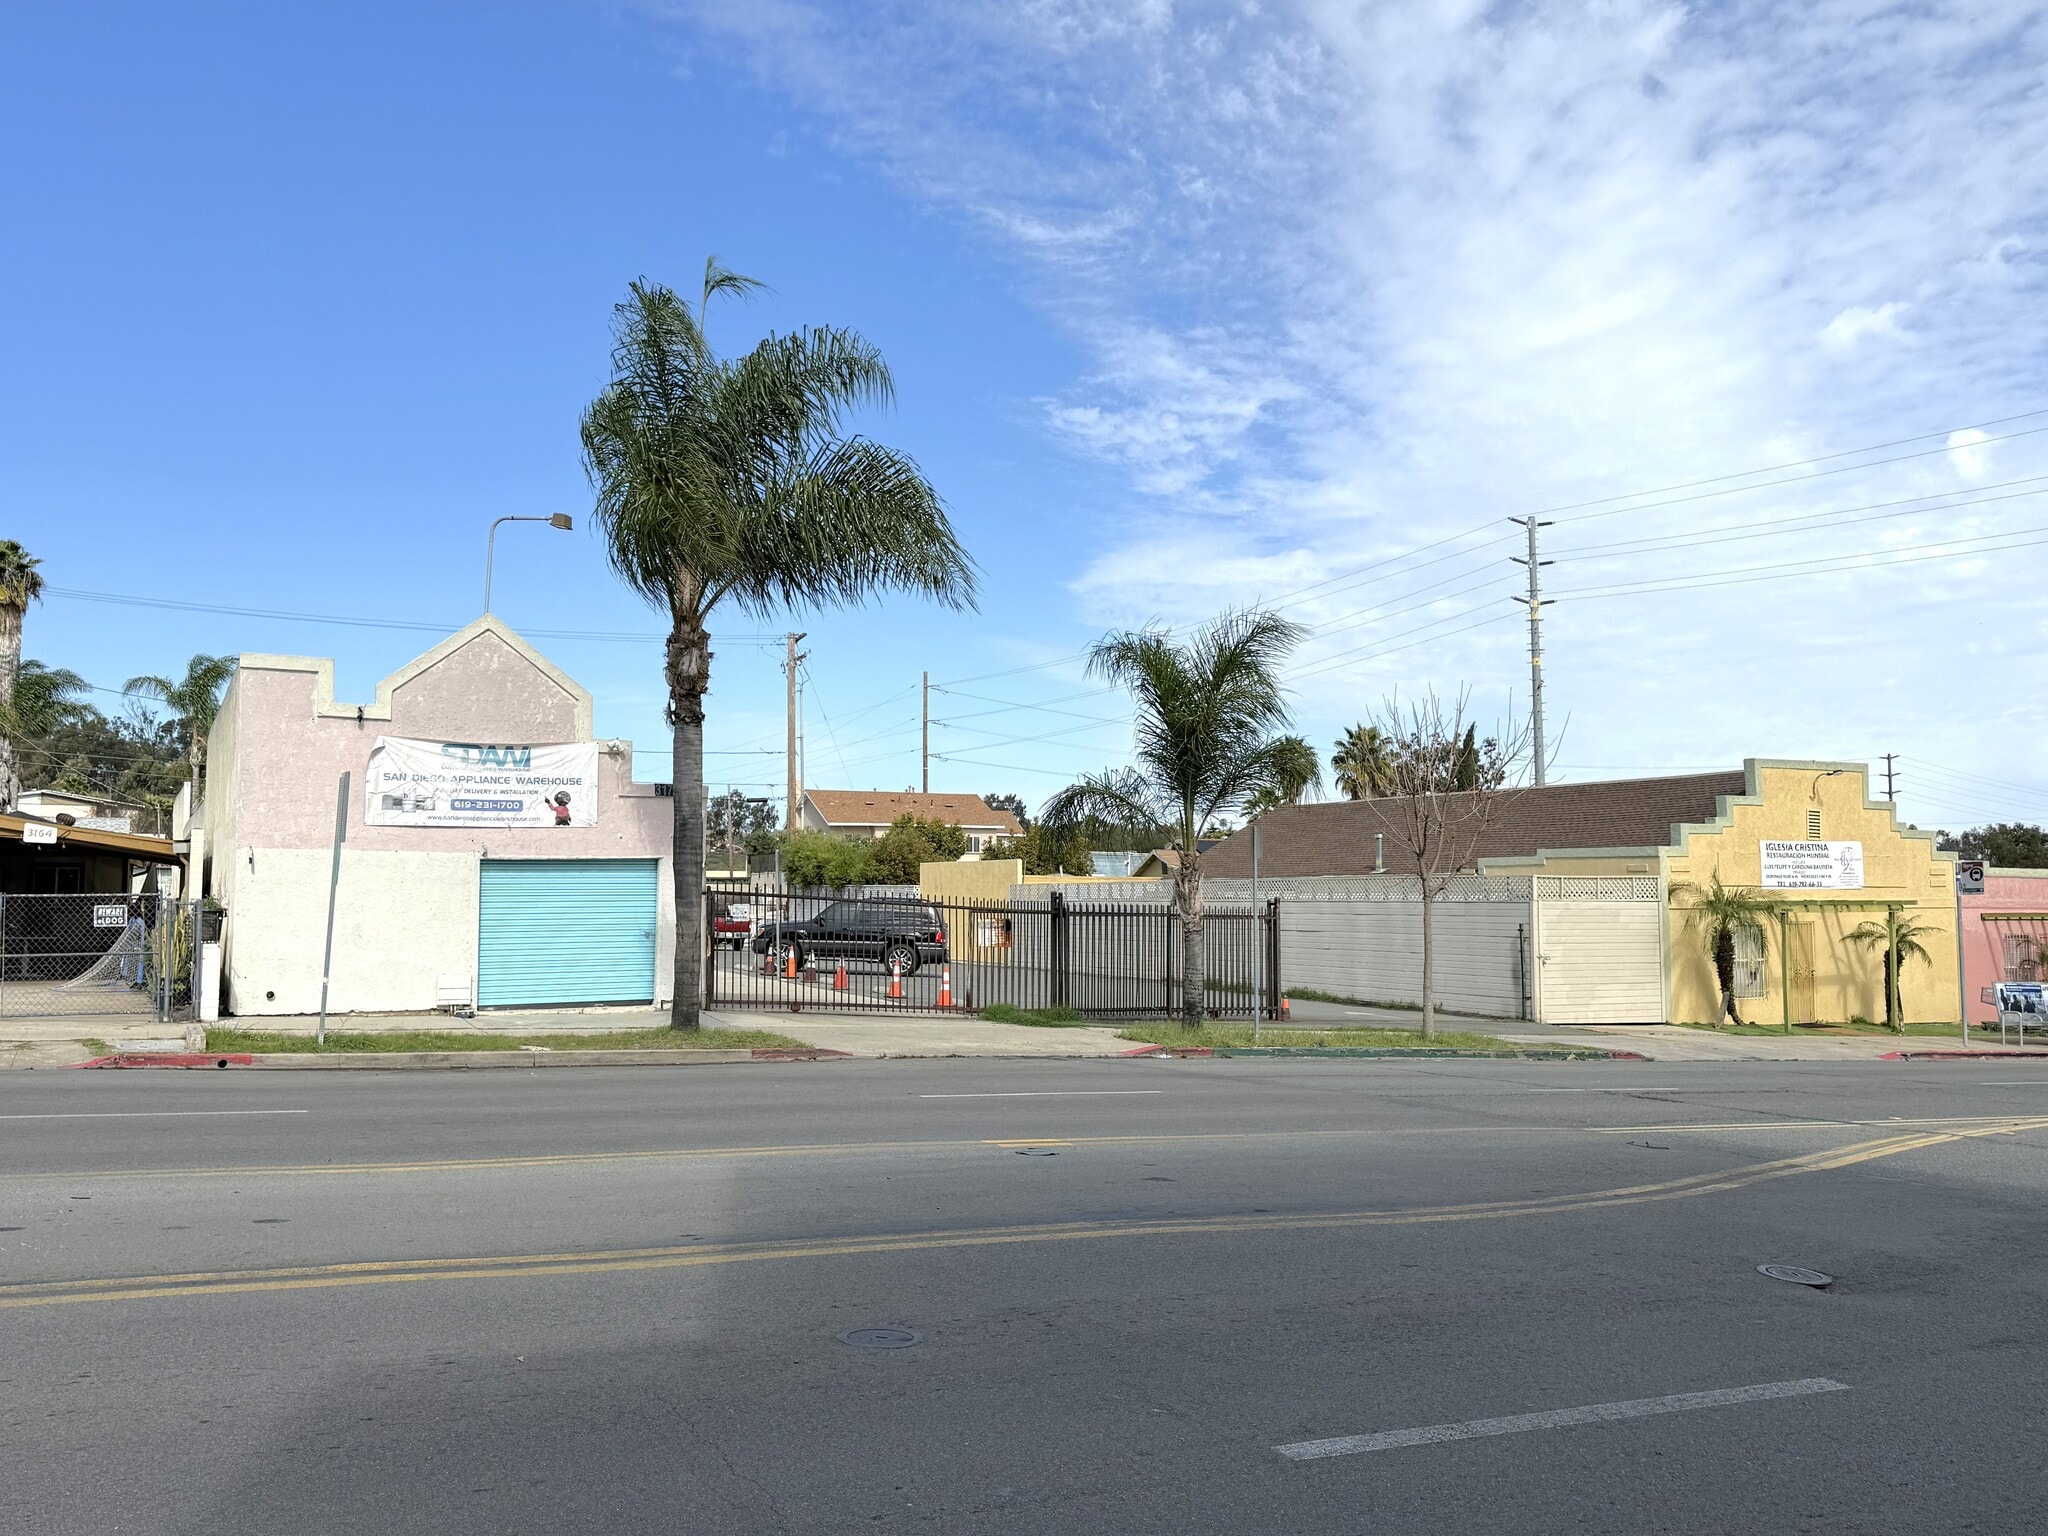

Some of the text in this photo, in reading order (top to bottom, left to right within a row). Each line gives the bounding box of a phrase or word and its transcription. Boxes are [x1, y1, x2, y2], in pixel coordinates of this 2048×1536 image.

[383, 772, 582, 786] SAN DIEGO APPLIANCE WAREHOUSE
[454, 801, 520, 809] 619-231-1700
[28, 829, 53, 838] 3164
[1765, 842, 1829, 851] IGLESIA CRISTINA
[98, 907, 124, 916] BEWARE
